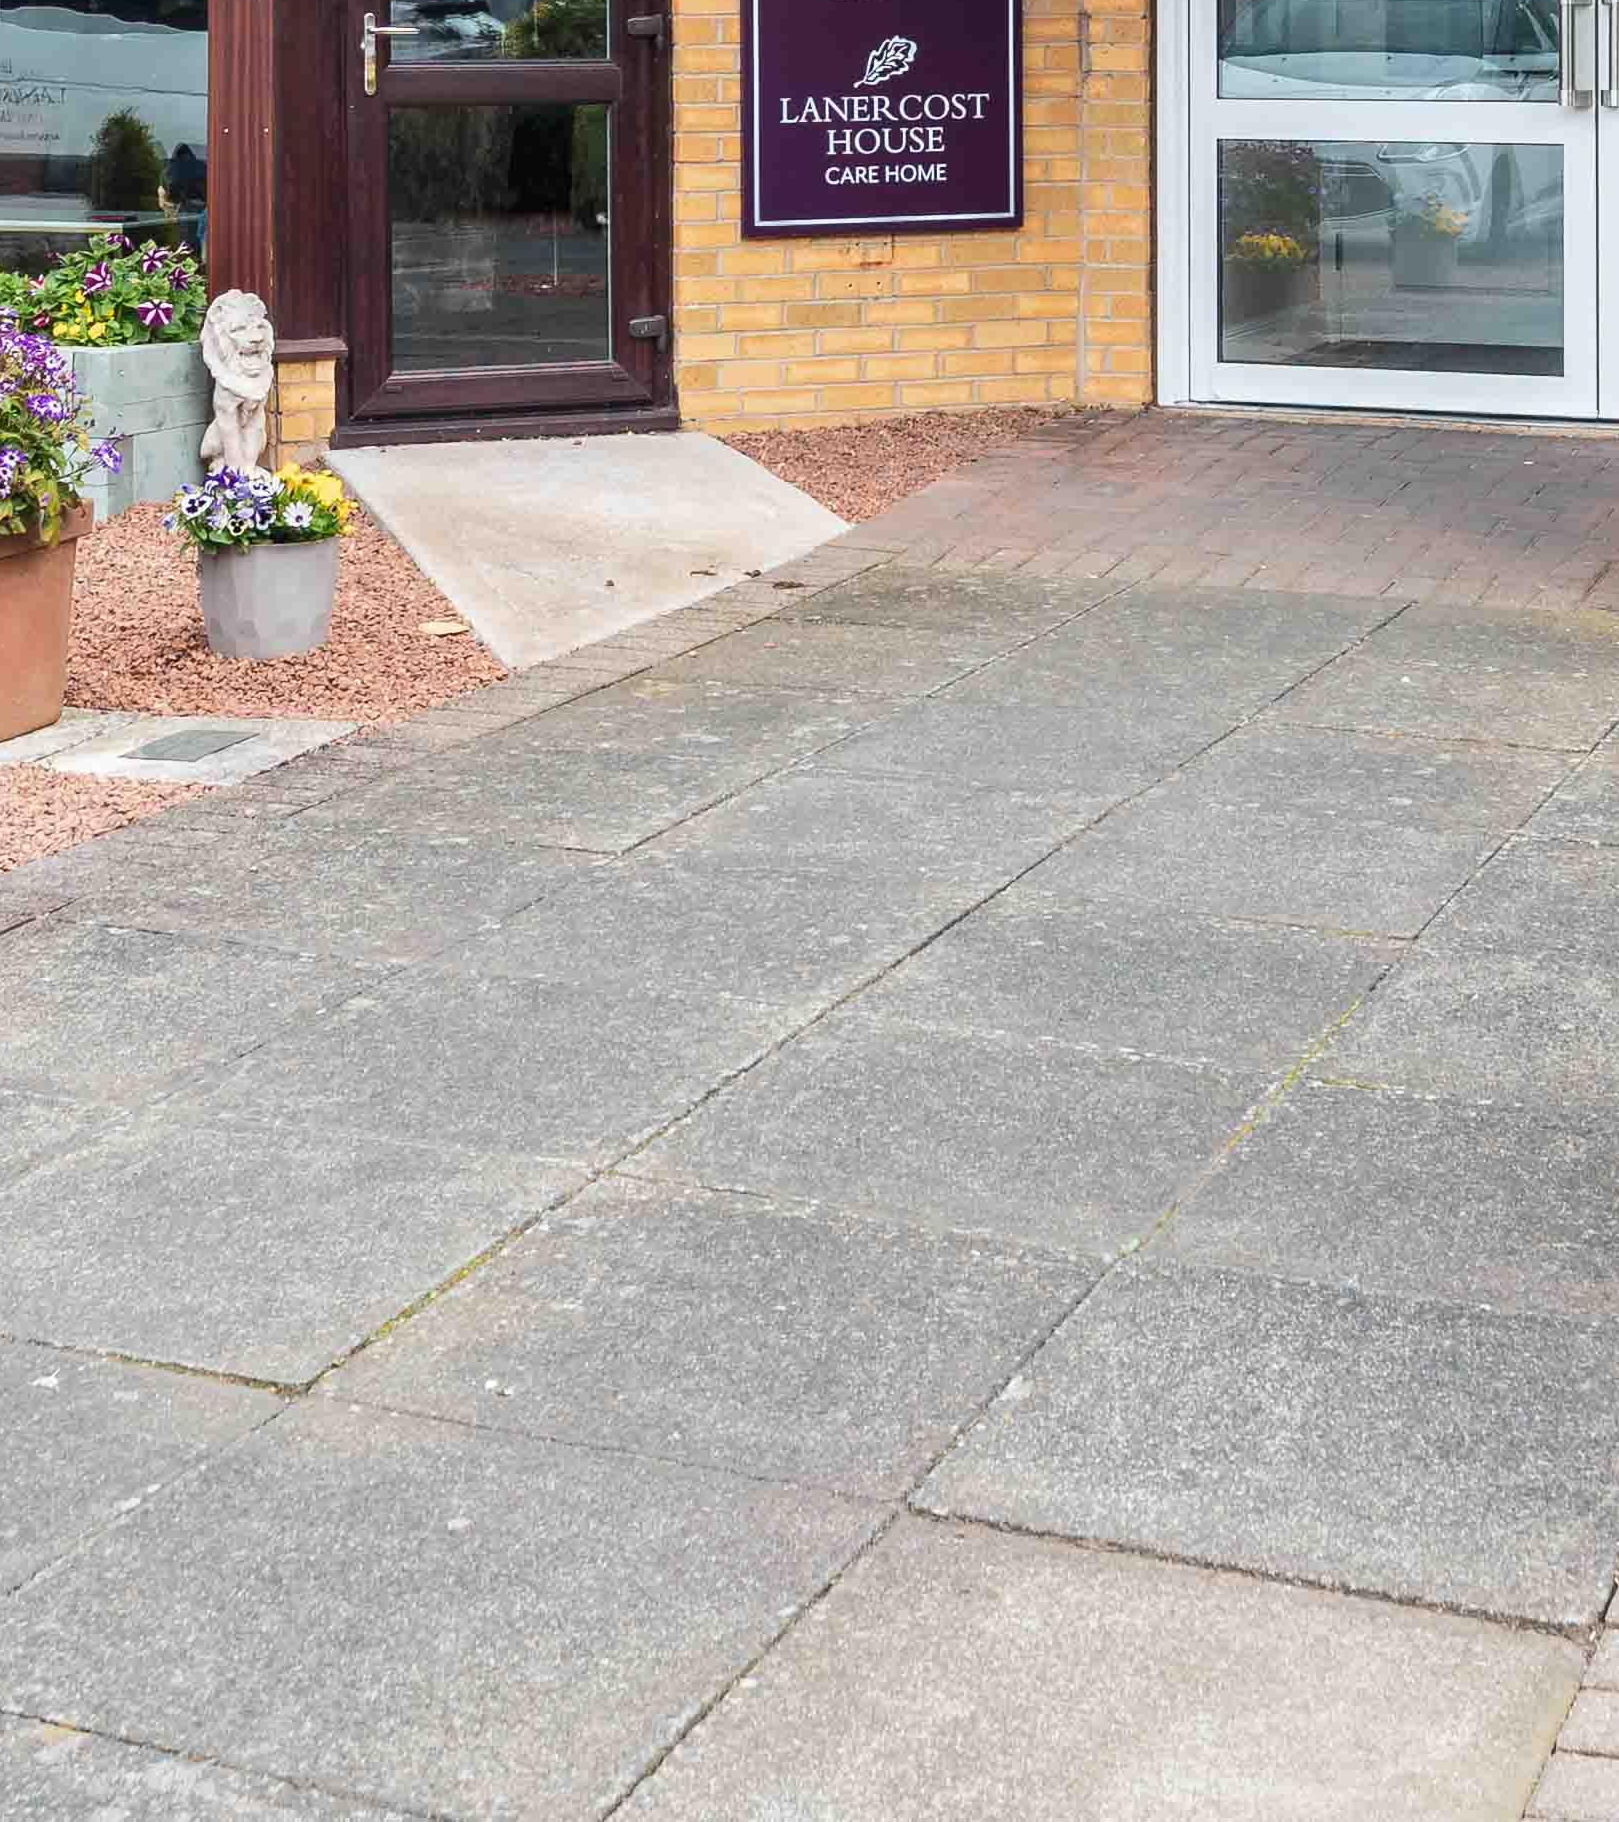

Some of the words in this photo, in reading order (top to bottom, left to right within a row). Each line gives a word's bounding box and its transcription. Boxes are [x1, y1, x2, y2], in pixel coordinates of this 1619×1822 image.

[780, 93, 990, 124] LANERCOST
[826, 127, 946, 155] HOUSE
[825, 166, 879, 185] CARE
[885, 163, 947, 183] HOME
